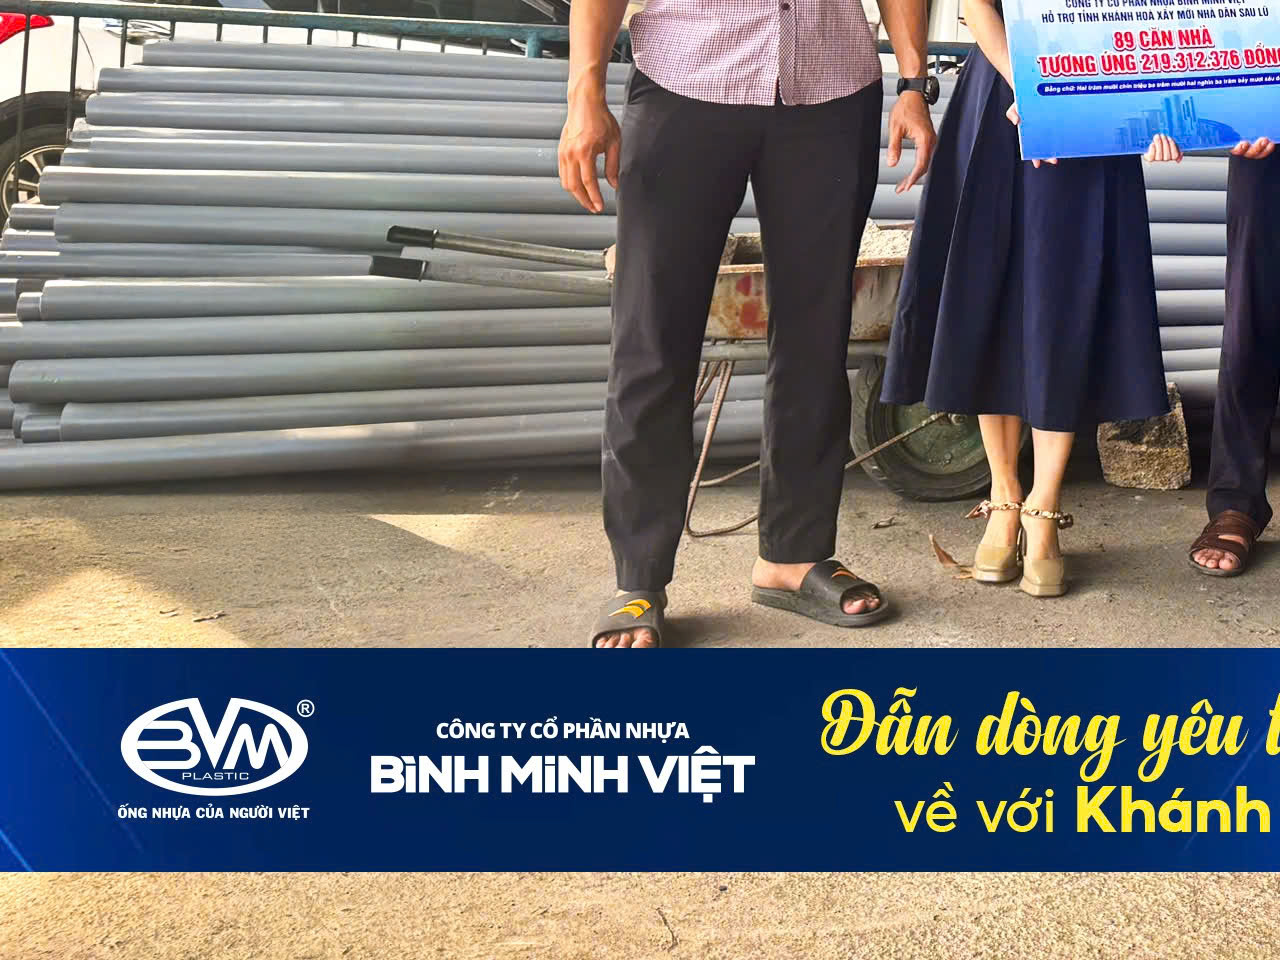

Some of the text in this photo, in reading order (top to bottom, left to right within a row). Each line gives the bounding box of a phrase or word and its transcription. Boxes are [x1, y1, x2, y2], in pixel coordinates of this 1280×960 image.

[1057, 12, 1075, 24] TRỢ
[1157, 9, 1174, 20] XÂY
[1218, 7, 1237, 18] DÂN
[1239, 7, 1256, 17] SAU
[1113, 25, 1214, 50] 89 CĂN NHÀ
[1038, 54, 1096, 76] TƯƠNG
[1100, 51, 1136, 75] ỨNG
[1141, 49, 1241, 73] 219.312.376
